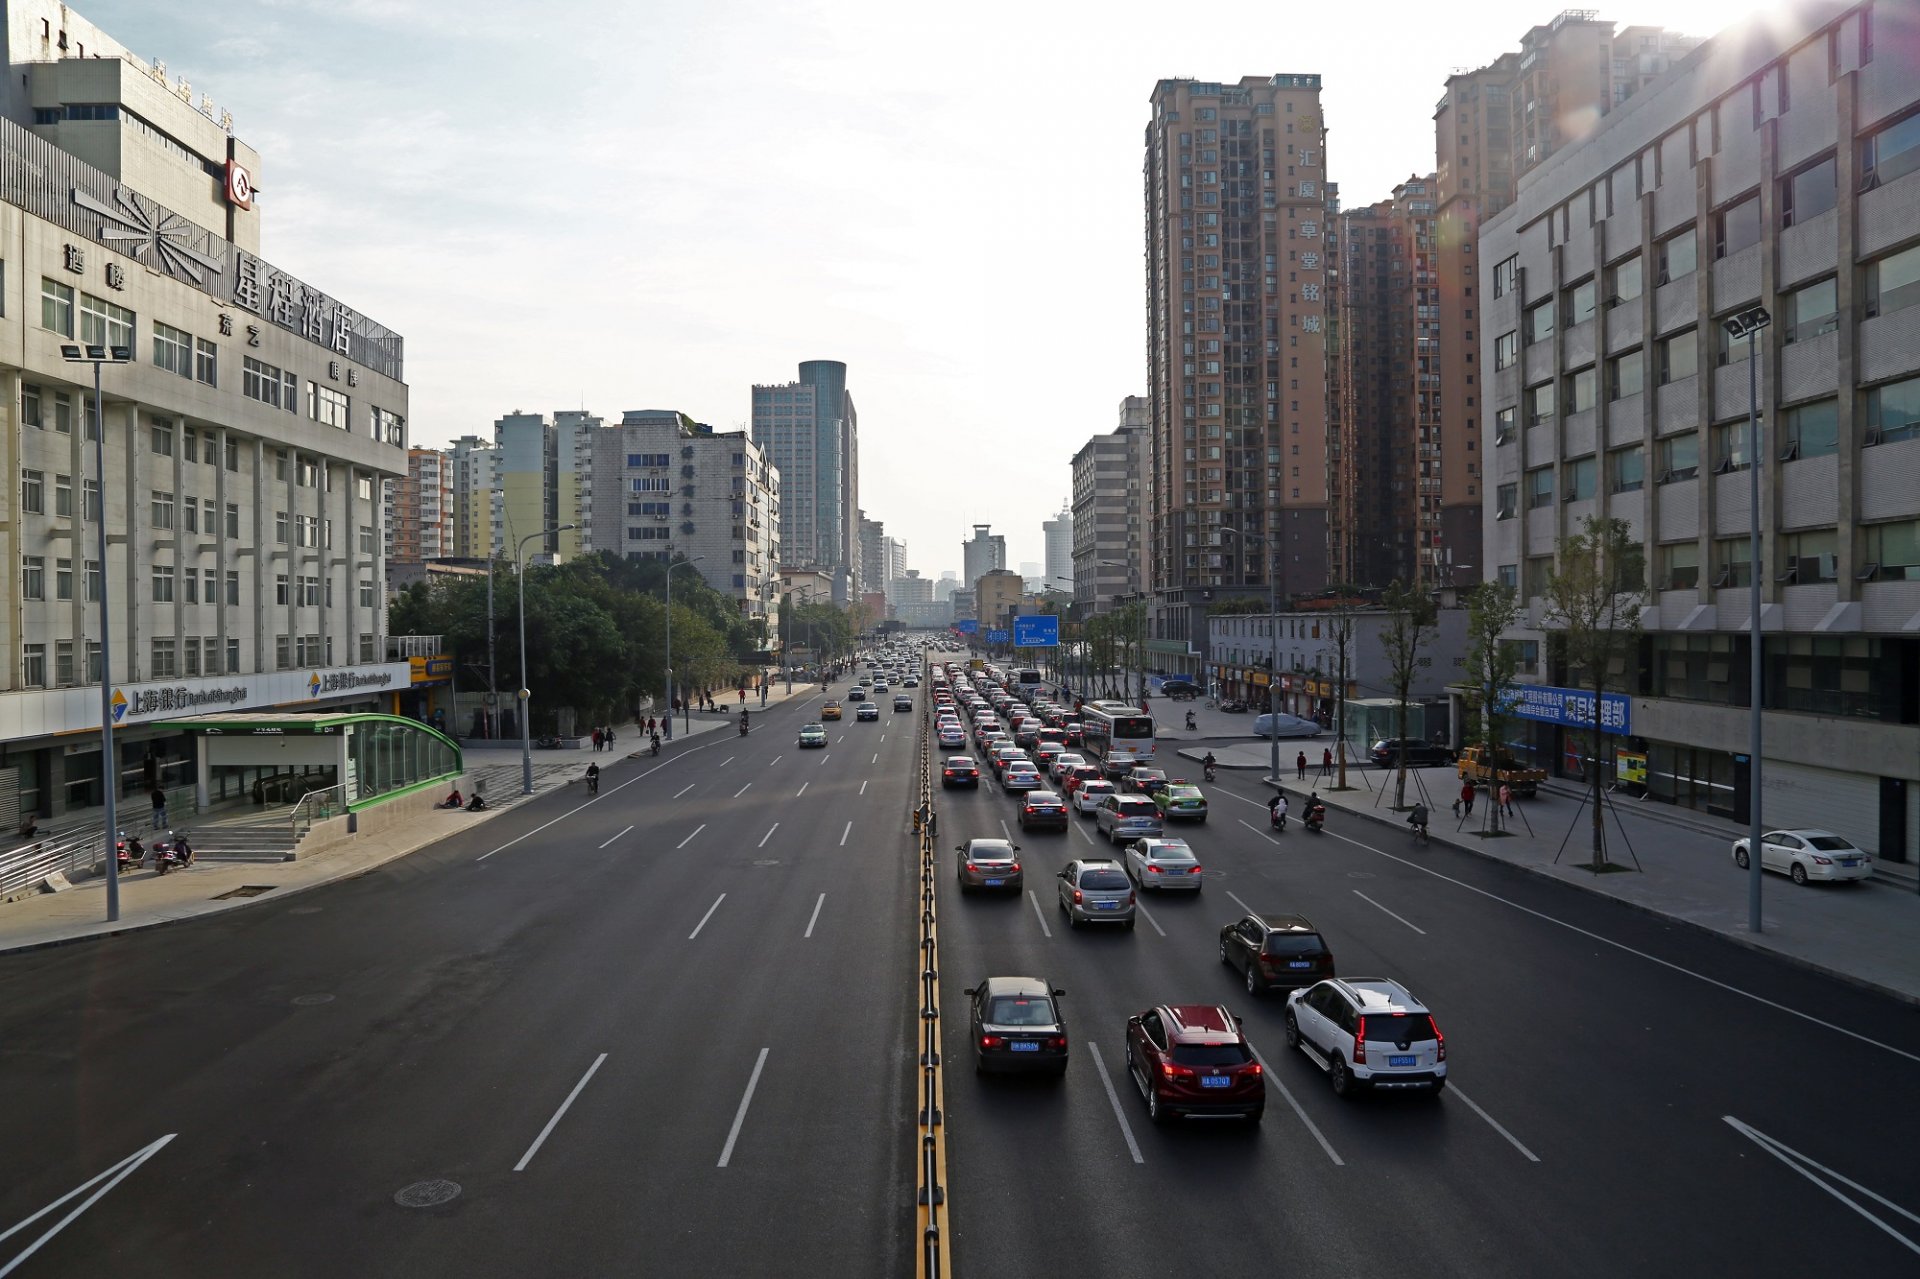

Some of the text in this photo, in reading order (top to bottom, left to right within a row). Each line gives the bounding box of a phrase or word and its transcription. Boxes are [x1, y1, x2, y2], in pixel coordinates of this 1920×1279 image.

[63, 243, 125, 292] 酒楼
[234, 251, 354, 355] 星程酒店
[320, 672, 355, 693] 上海银行
[128, 686, 188, 715] 上海银行
[188, 690, 207, 705] Bank
[216, 686, 248, 704] Shanghai
[1565, 695, 1625, 728] 项目经理部
